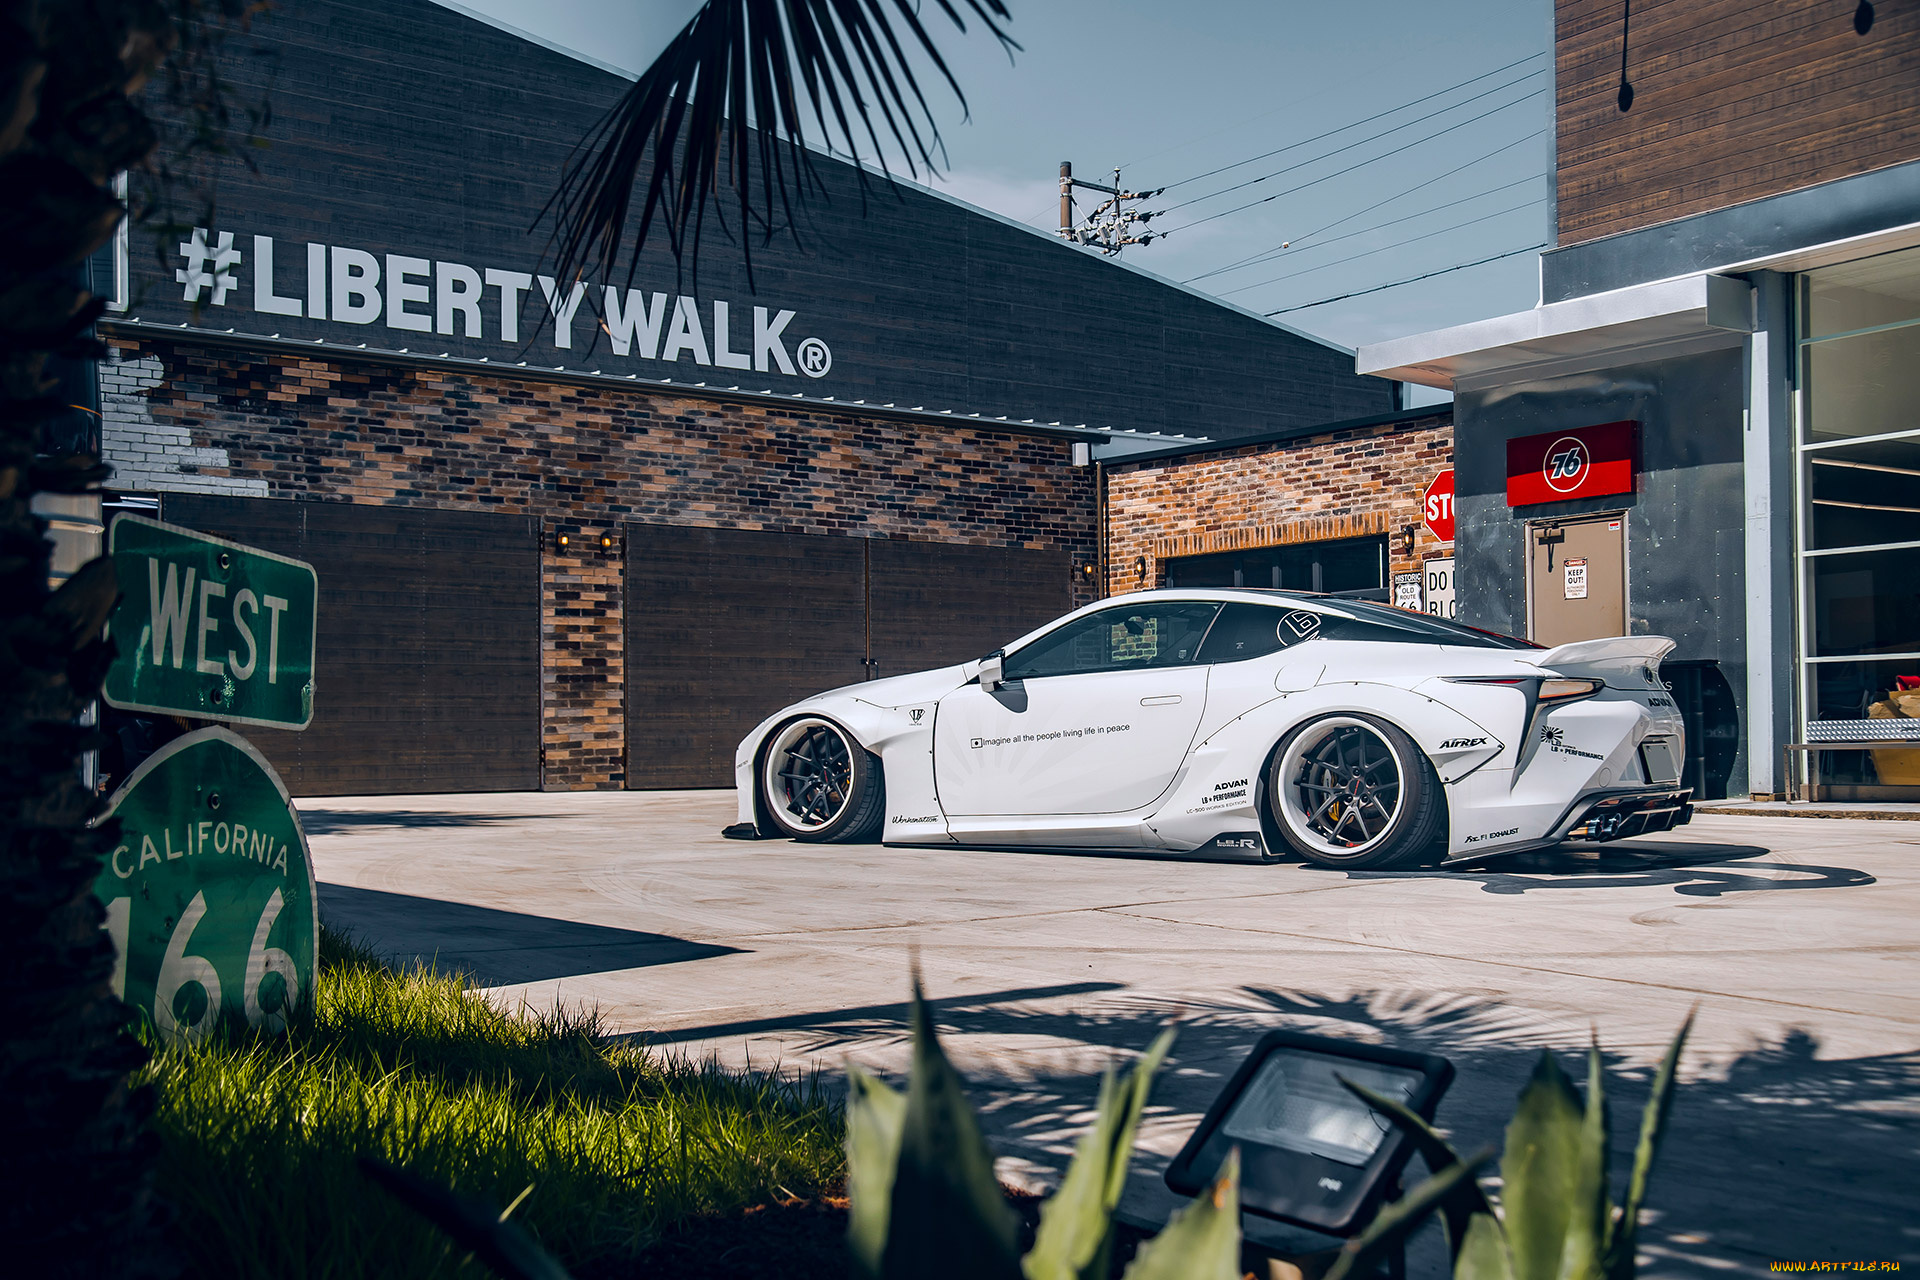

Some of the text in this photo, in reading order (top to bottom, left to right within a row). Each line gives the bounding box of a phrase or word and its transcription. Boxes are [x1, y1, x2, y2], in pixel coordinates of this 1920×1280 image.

[1550, 446, 1581, 479] 76
[1427, 493, 1455, 521] ST
[1395, 573, 1421, 583] HISTORIC
[1430, 571, 1447, 591] DO
[1568, 569, 1583, 577] KEEP
[149, 557, 288, 685] WEST
[983, 736, 1011, 746] Imagine
[1013, 735, 1021, 743] all
[1023, 734, 1035, 742] the
[1037, 731, 1061, 741] people
[1063, 729, 1082, 738] living
[1084, 727, 1096, 735] life
[1107, 724, 1130, 734] peace
[1214, 778, 1248, 791] ADVAN
[1213, 789, 1247, 802] PERFORMANCE
[112, 822, 288, 878] CALIFORNIA
